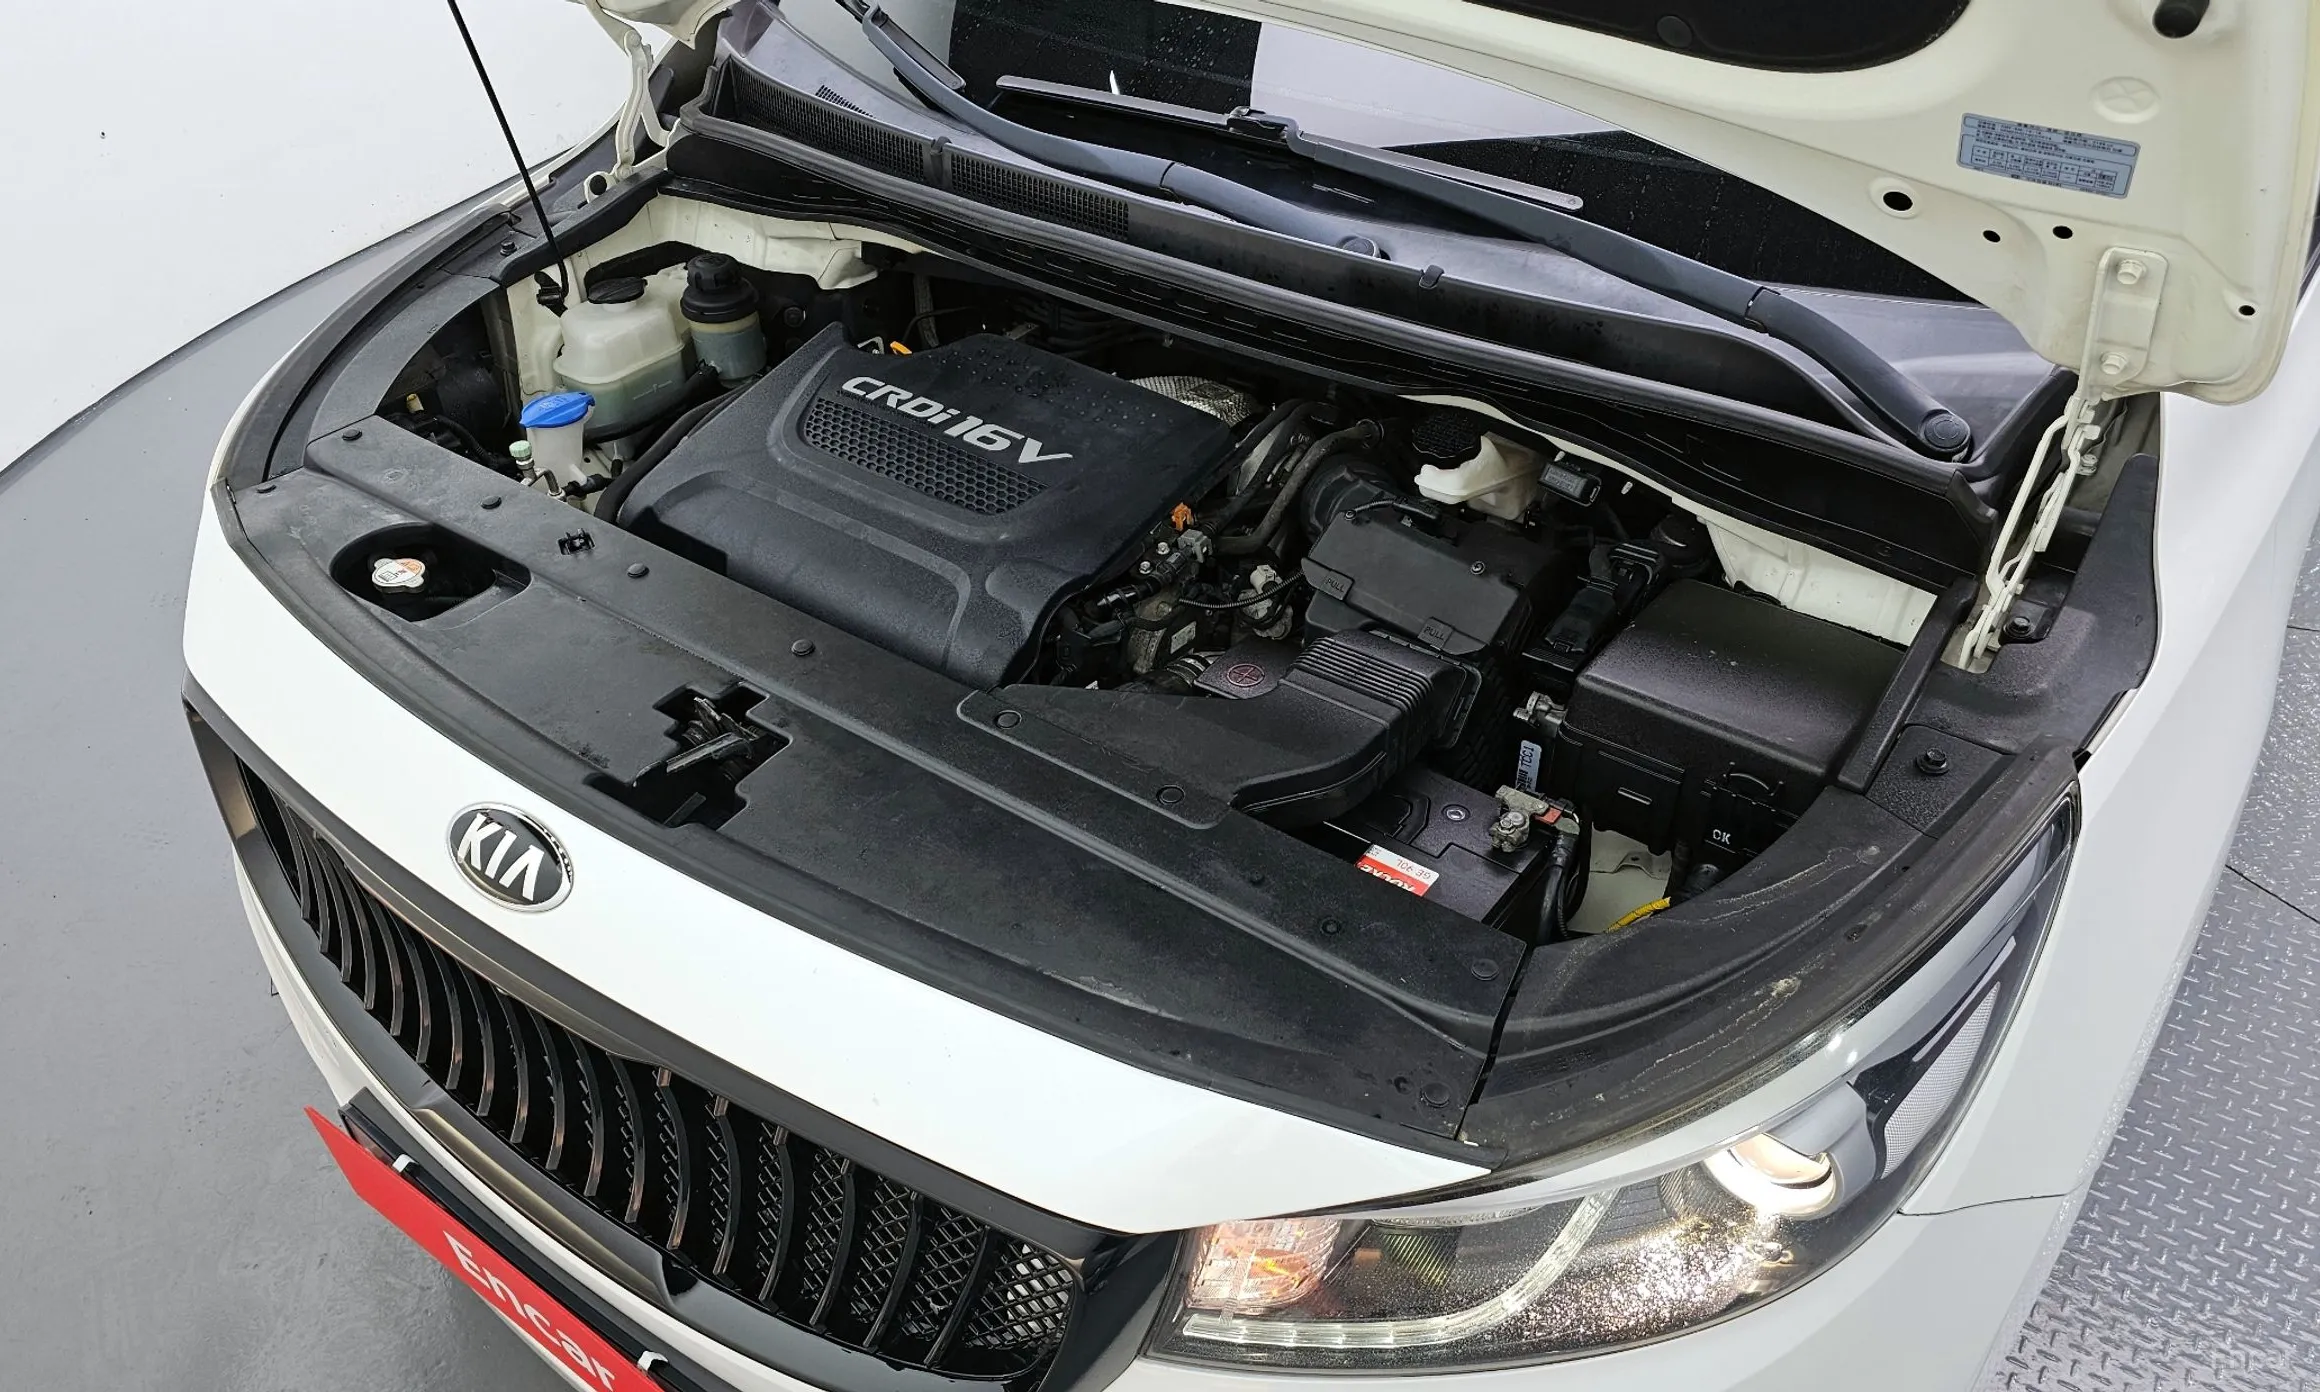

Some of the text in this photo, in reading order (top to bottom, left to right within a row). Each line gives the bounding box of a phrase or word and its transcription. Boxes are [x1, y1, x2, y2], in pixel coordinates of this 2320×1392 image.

[1326, 577, 1345, 593] PULL
[1424, 626, 1444, 641] PULL
[458, 812, 545, 902] KIA
[442, 1230, 615, 1392] Encar
